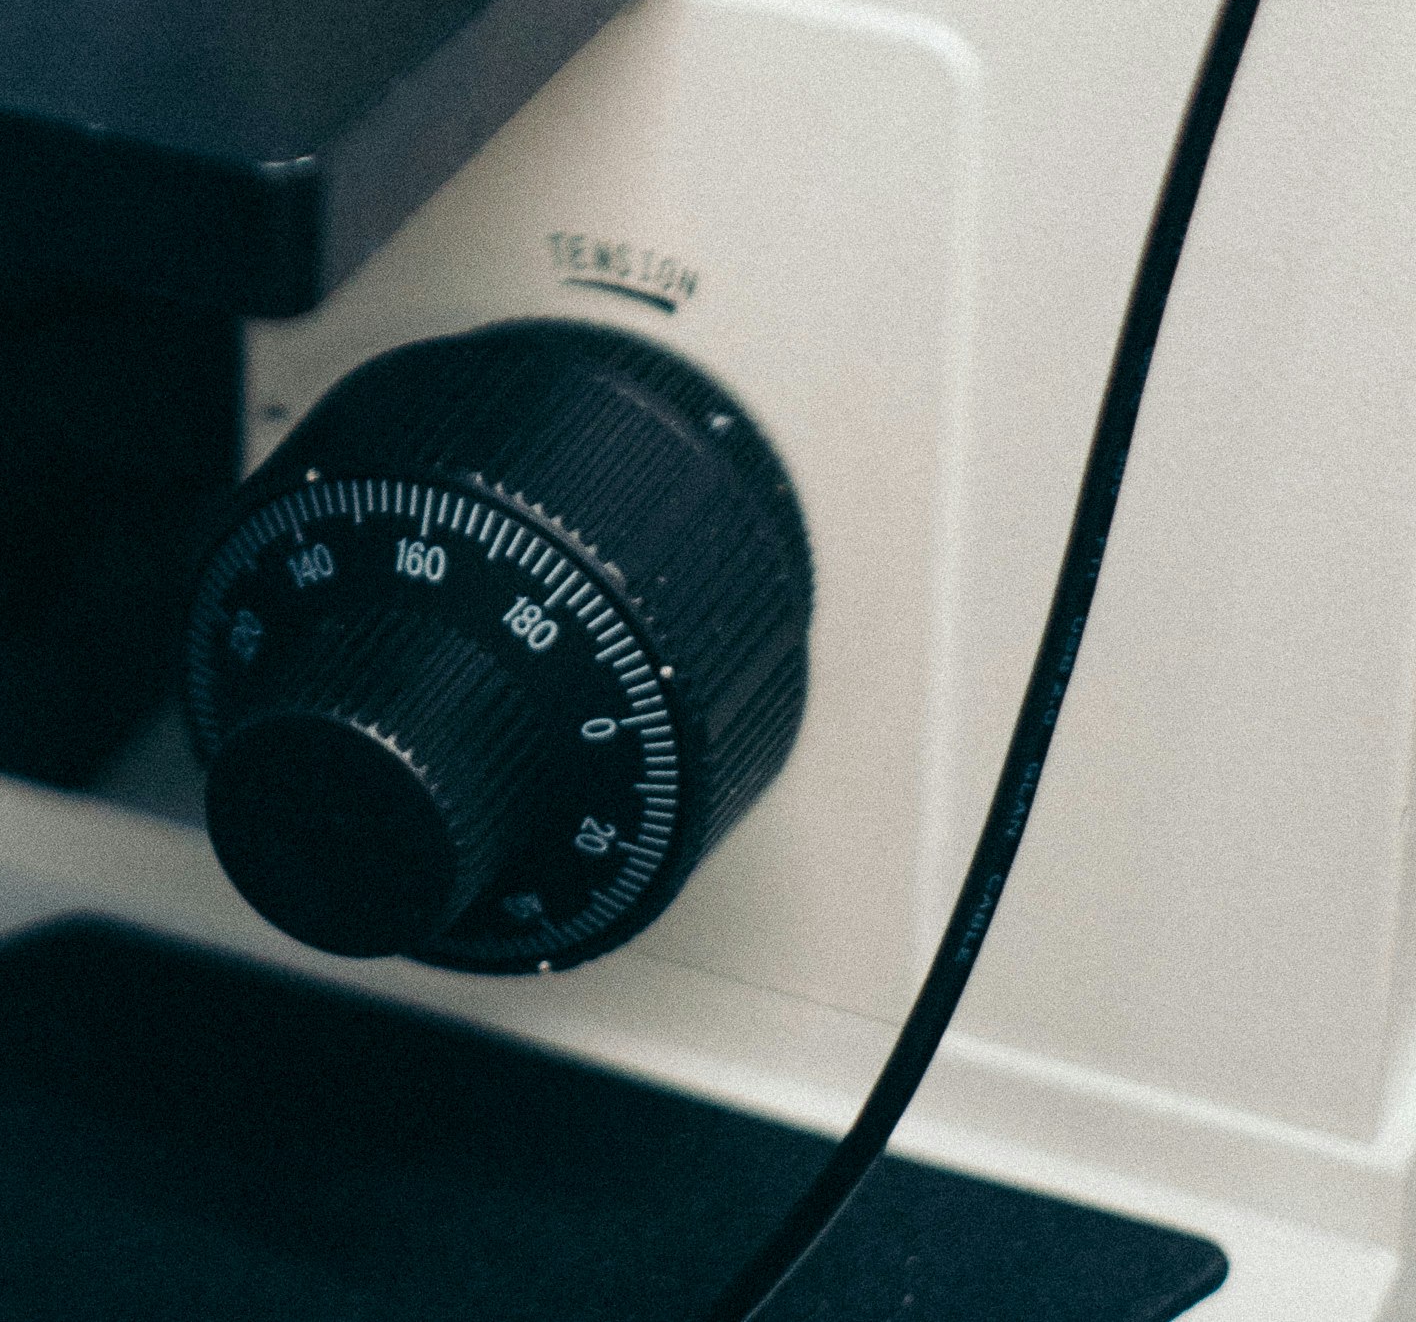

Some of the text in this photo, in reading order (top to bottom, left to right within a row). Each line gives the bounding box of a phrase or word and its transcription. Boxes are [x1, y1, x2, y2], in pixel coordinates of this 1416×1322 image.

[546, 231, 700, 299] TENSION
[288, 542, 335, 589] 140
[395, 537, 447, 584] 160
[501, 595, 559, 651] 180
[580, 717, 619, 741] 0
[574, 815, 617, 855] 20
